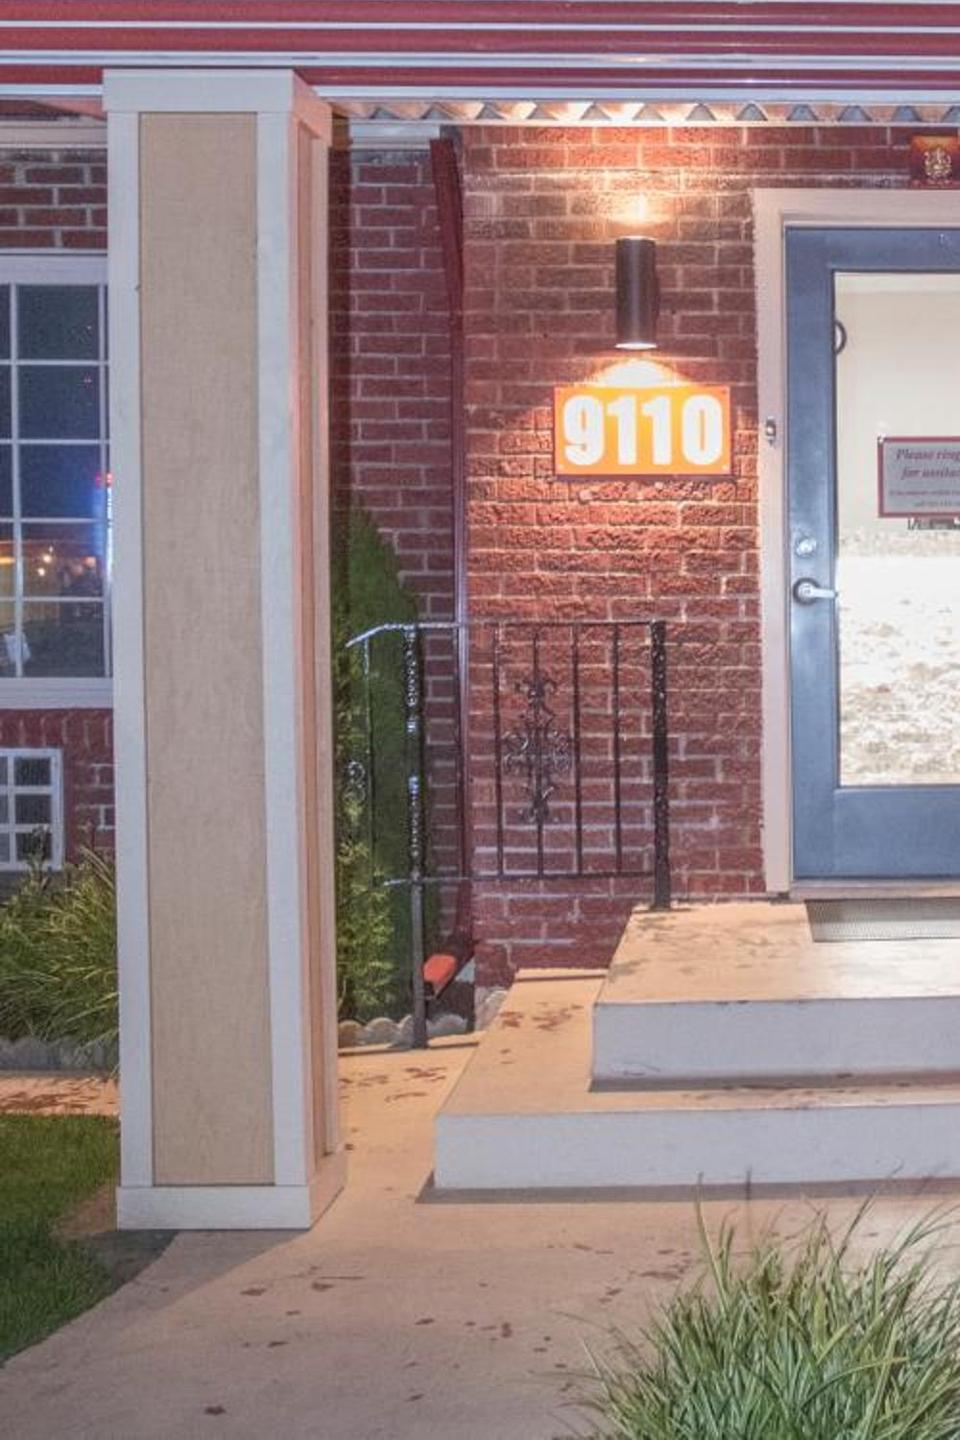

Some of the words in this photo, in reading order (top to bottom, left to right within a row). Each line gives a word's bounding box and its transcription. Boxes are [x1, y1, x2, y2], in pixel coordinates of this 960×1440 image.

[562, 394, 724, 466] 9110
[896, 447, 935, 460] Please
[936, 447, 960, 462] ring
[900, 466, 920, 480] for
